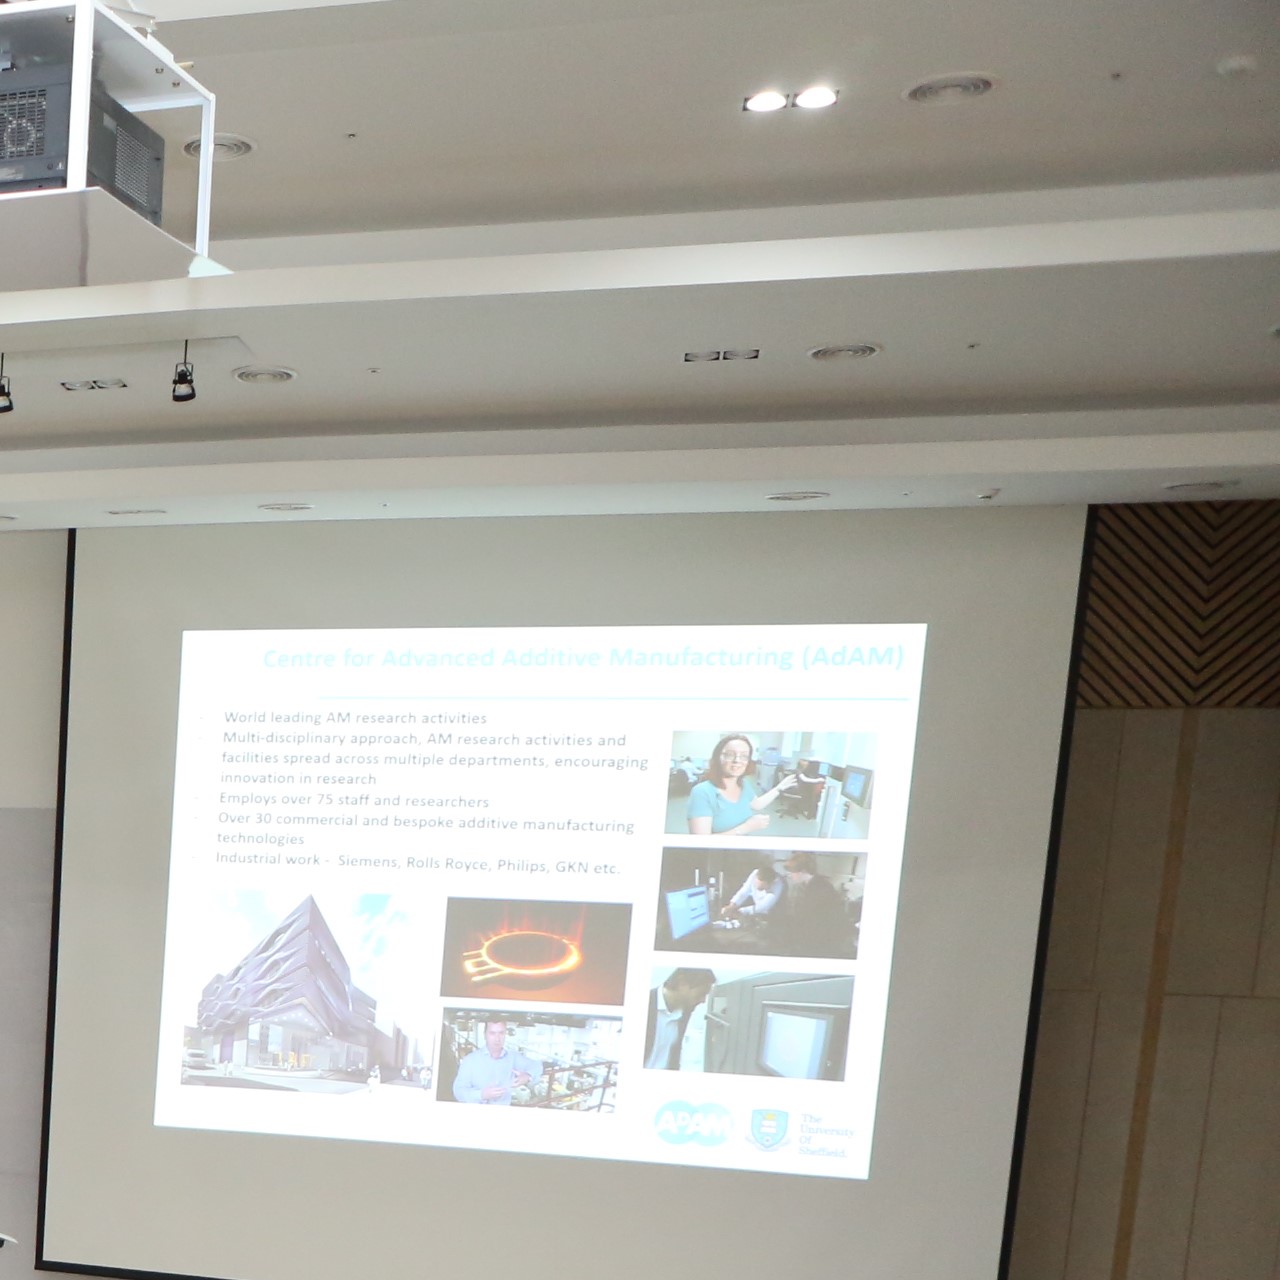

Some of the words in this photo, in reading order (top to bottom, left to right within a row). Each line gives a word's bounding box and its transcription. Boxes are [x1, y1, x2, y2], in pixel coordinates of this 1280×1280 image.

[262, 650, 337, 667] Centre
[342, 648, 376, 667] for
[380, 648, 496, 667] Advanced
[500, 648, 603, 666] Additive
[607, 646, 795, 671] Manufacturing
[800, 644, 905, 671] (AdAM)
[224, 712, 265, 722] World
[270, 712, 321, 725] leading
[326, 712, 350, 723] AM
[355, 712, 416, 723] research
[421, 712, 486, 724] activities
[223, 732, 345, 746] Multi-disciplinary
[350, 733, 421, 746] approach,
[426, 733, 452, 744] AM
[457, 734, 520, 745] research
[525, 736, 592, 746] activities
[597, 735, 626, 746] and
[221, 752, 278, 763] facilities
[282, 753, 330, 766] spread
[334, 755, 379, 765] across
[383, 754, 444, 767] multiple
[448, 754, 549, 768] departments,
[554, 756, 648, 771] encouraging
[220, 774, 294, 783] innovation
[299, 773, 312, 784] in
[316, 774, 376, 784] research
[219, 792, 277, 806] Employs
[280, 795, 312, 805] over
[316, 794, 333, 804] 75
[337, 794, 370, 805] staff
[373, 795, 400, 806] and
[404, 796, 490, 808] researchers
[218, 812, 250, 823] Over
[255, 813, 271, 824] 30
[276, 815, 357, 825] commercial
[362, 816, 388, 826] and
[393, 816, 453, 829] bespoke
[458, 817, 518, 829] additive
[523, 819, 634, 835] manufacturing
[216, 832, 304, 847] technologies
[216, 852, 280, 864] Industrial
[285, 854, 319, 865] work
[338, 855, 400, 869] Siemens,
[406, 857, 440, 868] Rolls
[445, 858, 491, 872] Royce,
[497, 859, 549, 874] Philips,
[555, 861, 588, 873] GKN
[593, 864, 619, 874] etc.
